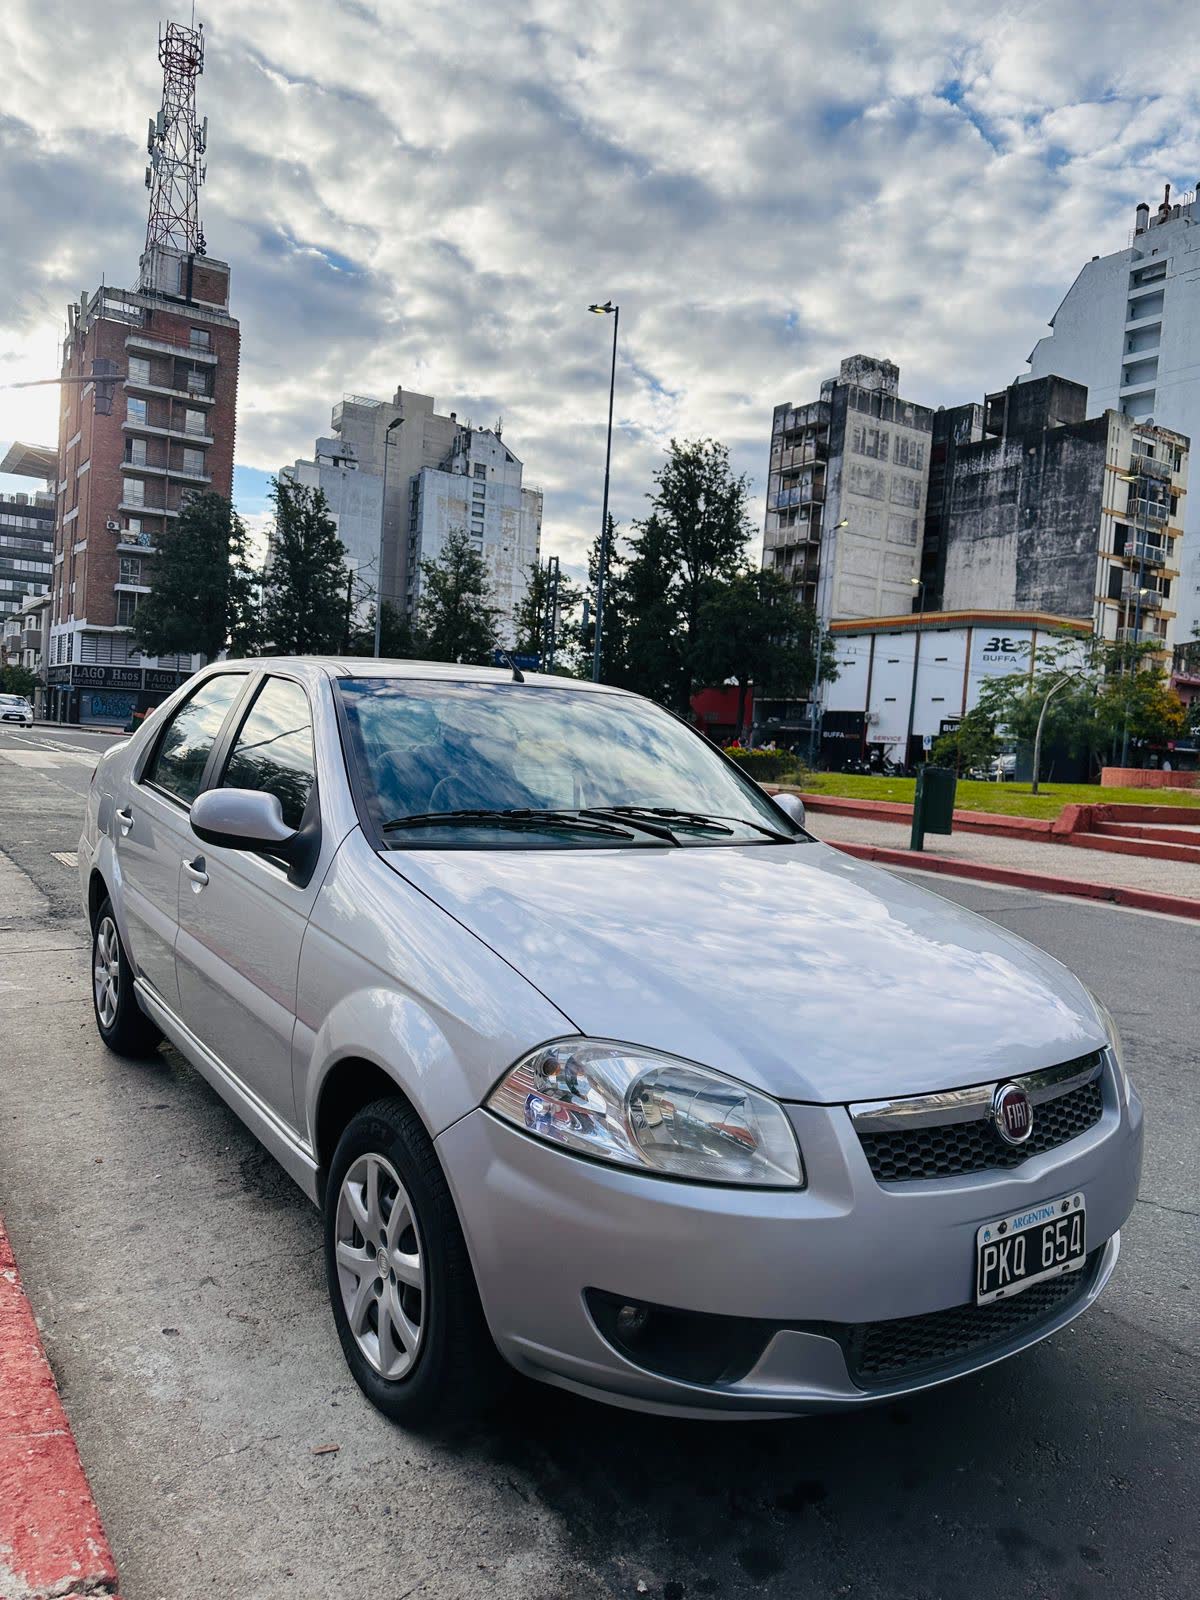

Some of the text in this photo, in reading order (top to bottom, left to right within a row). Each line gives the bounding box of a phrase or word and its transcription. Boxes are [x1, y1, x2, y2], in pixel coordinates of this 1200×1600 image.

[73, 666, 105, 679] LAGO
[146, 673, 173, 684] LAGO
[1006, 1101, 1028, 1130] FIAT
[1012, 1205, 1056, 1231] ARGENTINA
[982, 1215, 1081, 1291] PKQ 654
